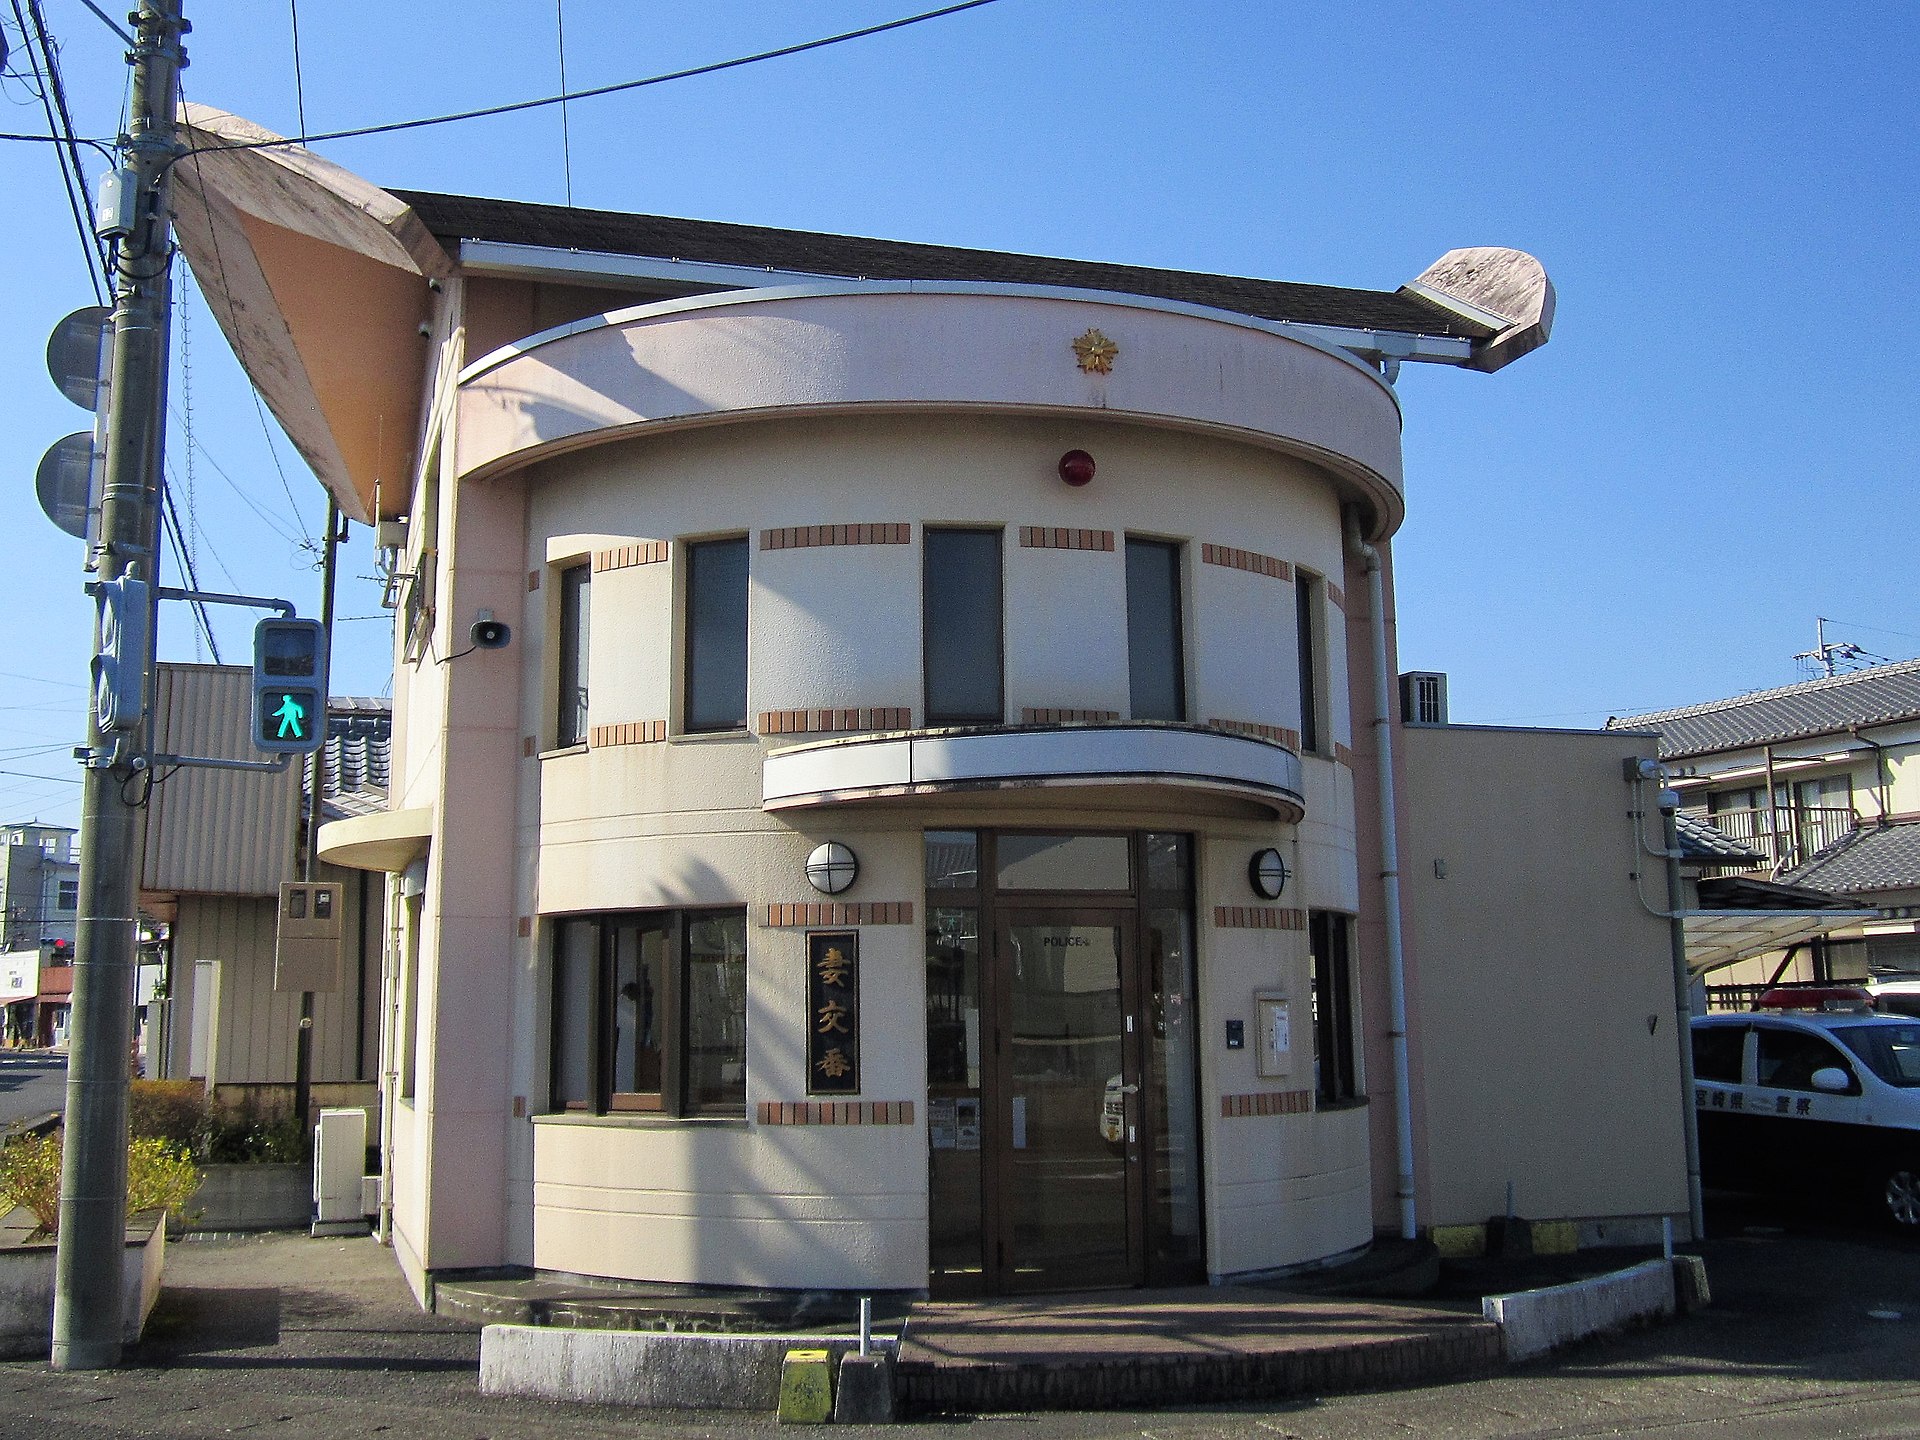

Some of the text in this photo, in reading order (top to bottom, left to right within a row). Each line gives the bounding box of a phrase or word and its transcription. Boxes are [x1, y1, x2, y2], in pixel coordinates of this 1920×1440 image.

[1043, 936, 1083, 947] POLICE
[816, 947, 851, 1078] 妻交番
